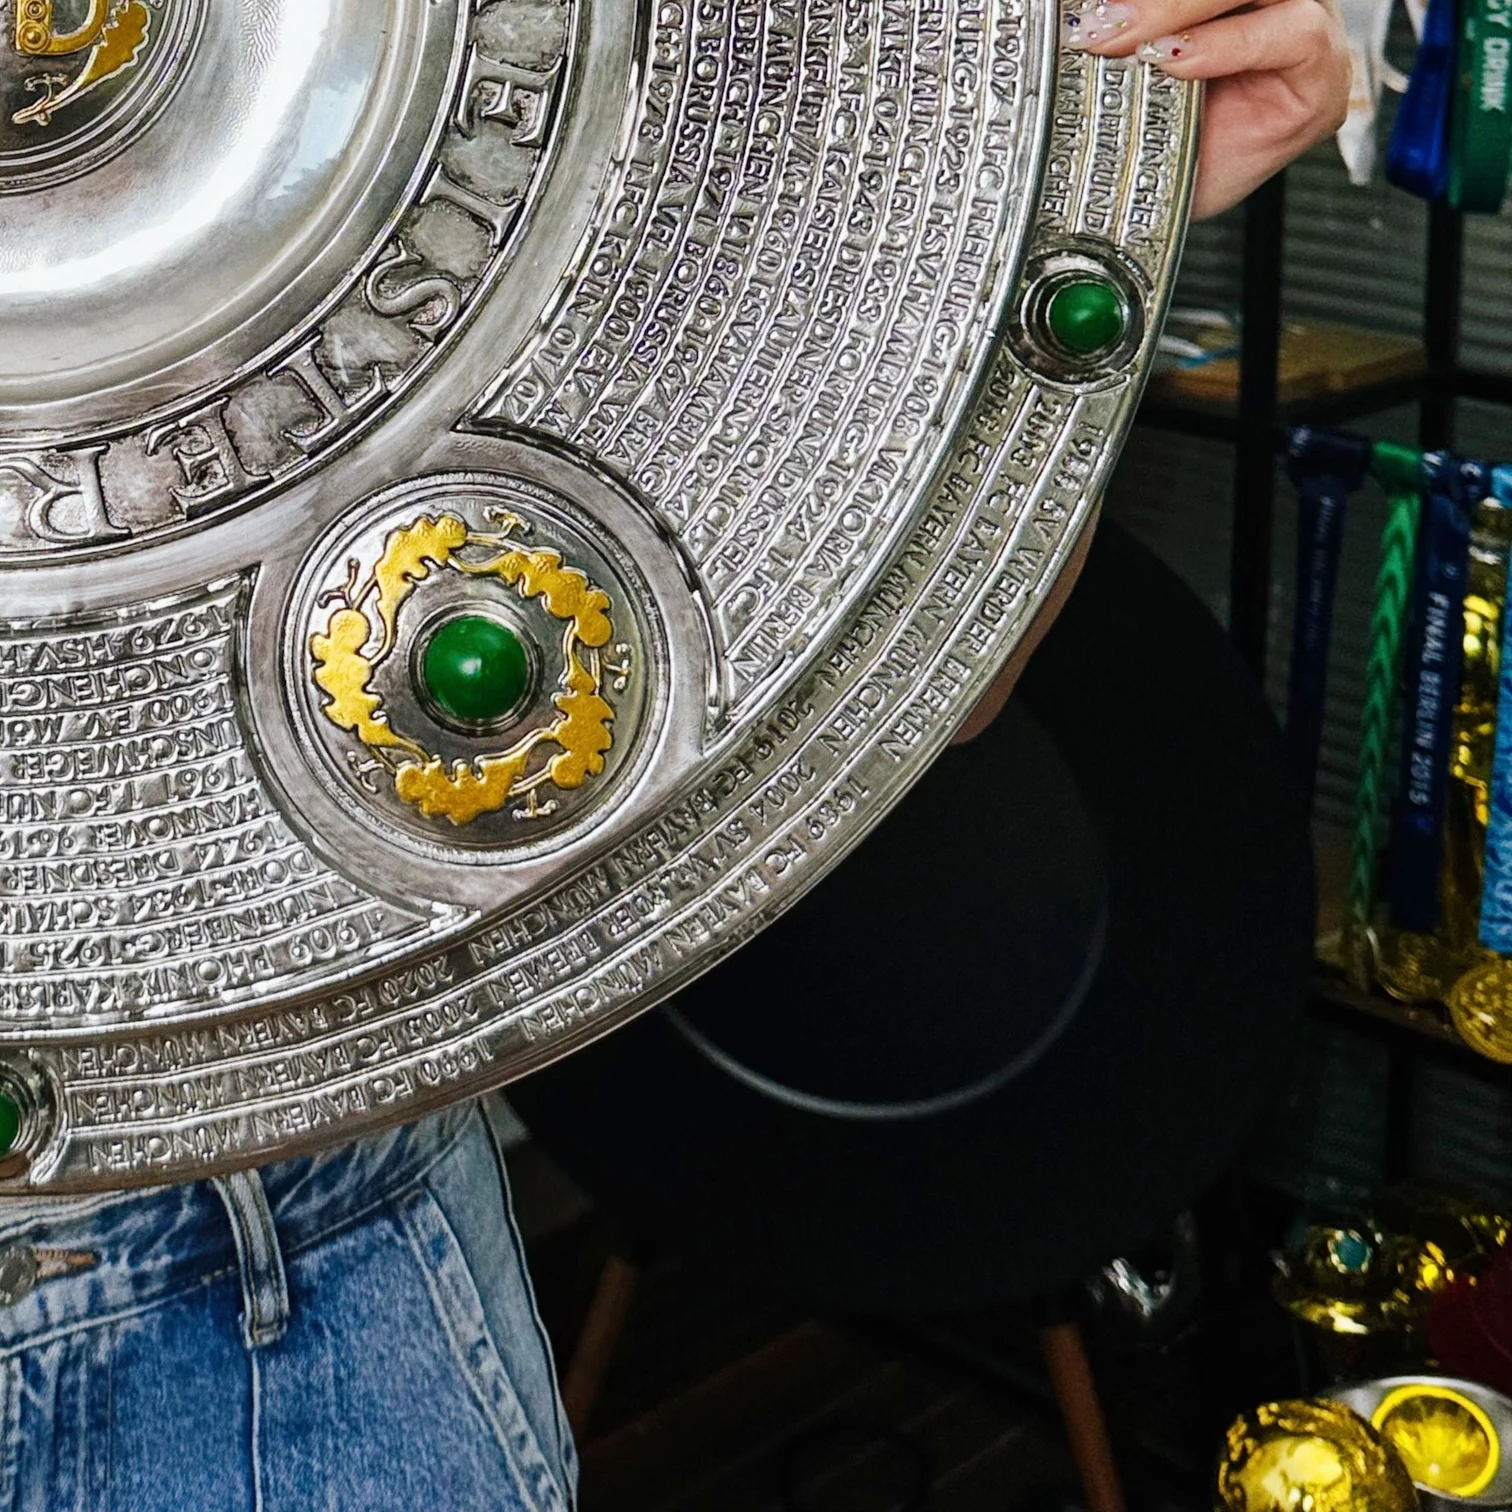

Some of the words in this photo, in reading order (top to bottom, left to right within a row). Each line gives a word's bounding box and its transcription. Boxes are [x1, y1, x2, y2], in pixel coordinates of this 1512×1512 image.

[1479, 37, 1510, 114] DRINK
[955, 540, 1045, 660] WERDER
[1421, 591, 1451, 665] FINAL
[876, 652, 975, 766] BREMEN
[1413, 669, 1442, 749] BERLIN
[760, 832, 809, 881] FC
[661, 864, 772, 961] BAYERN
[518, 940, 672, 1051] MÜNCHEN
[249, 1083, 369, 1147] BAYERN
[366, 1067, 417, 1111] FC
[84, 1116, 244, 1176] MÜNCHEN
